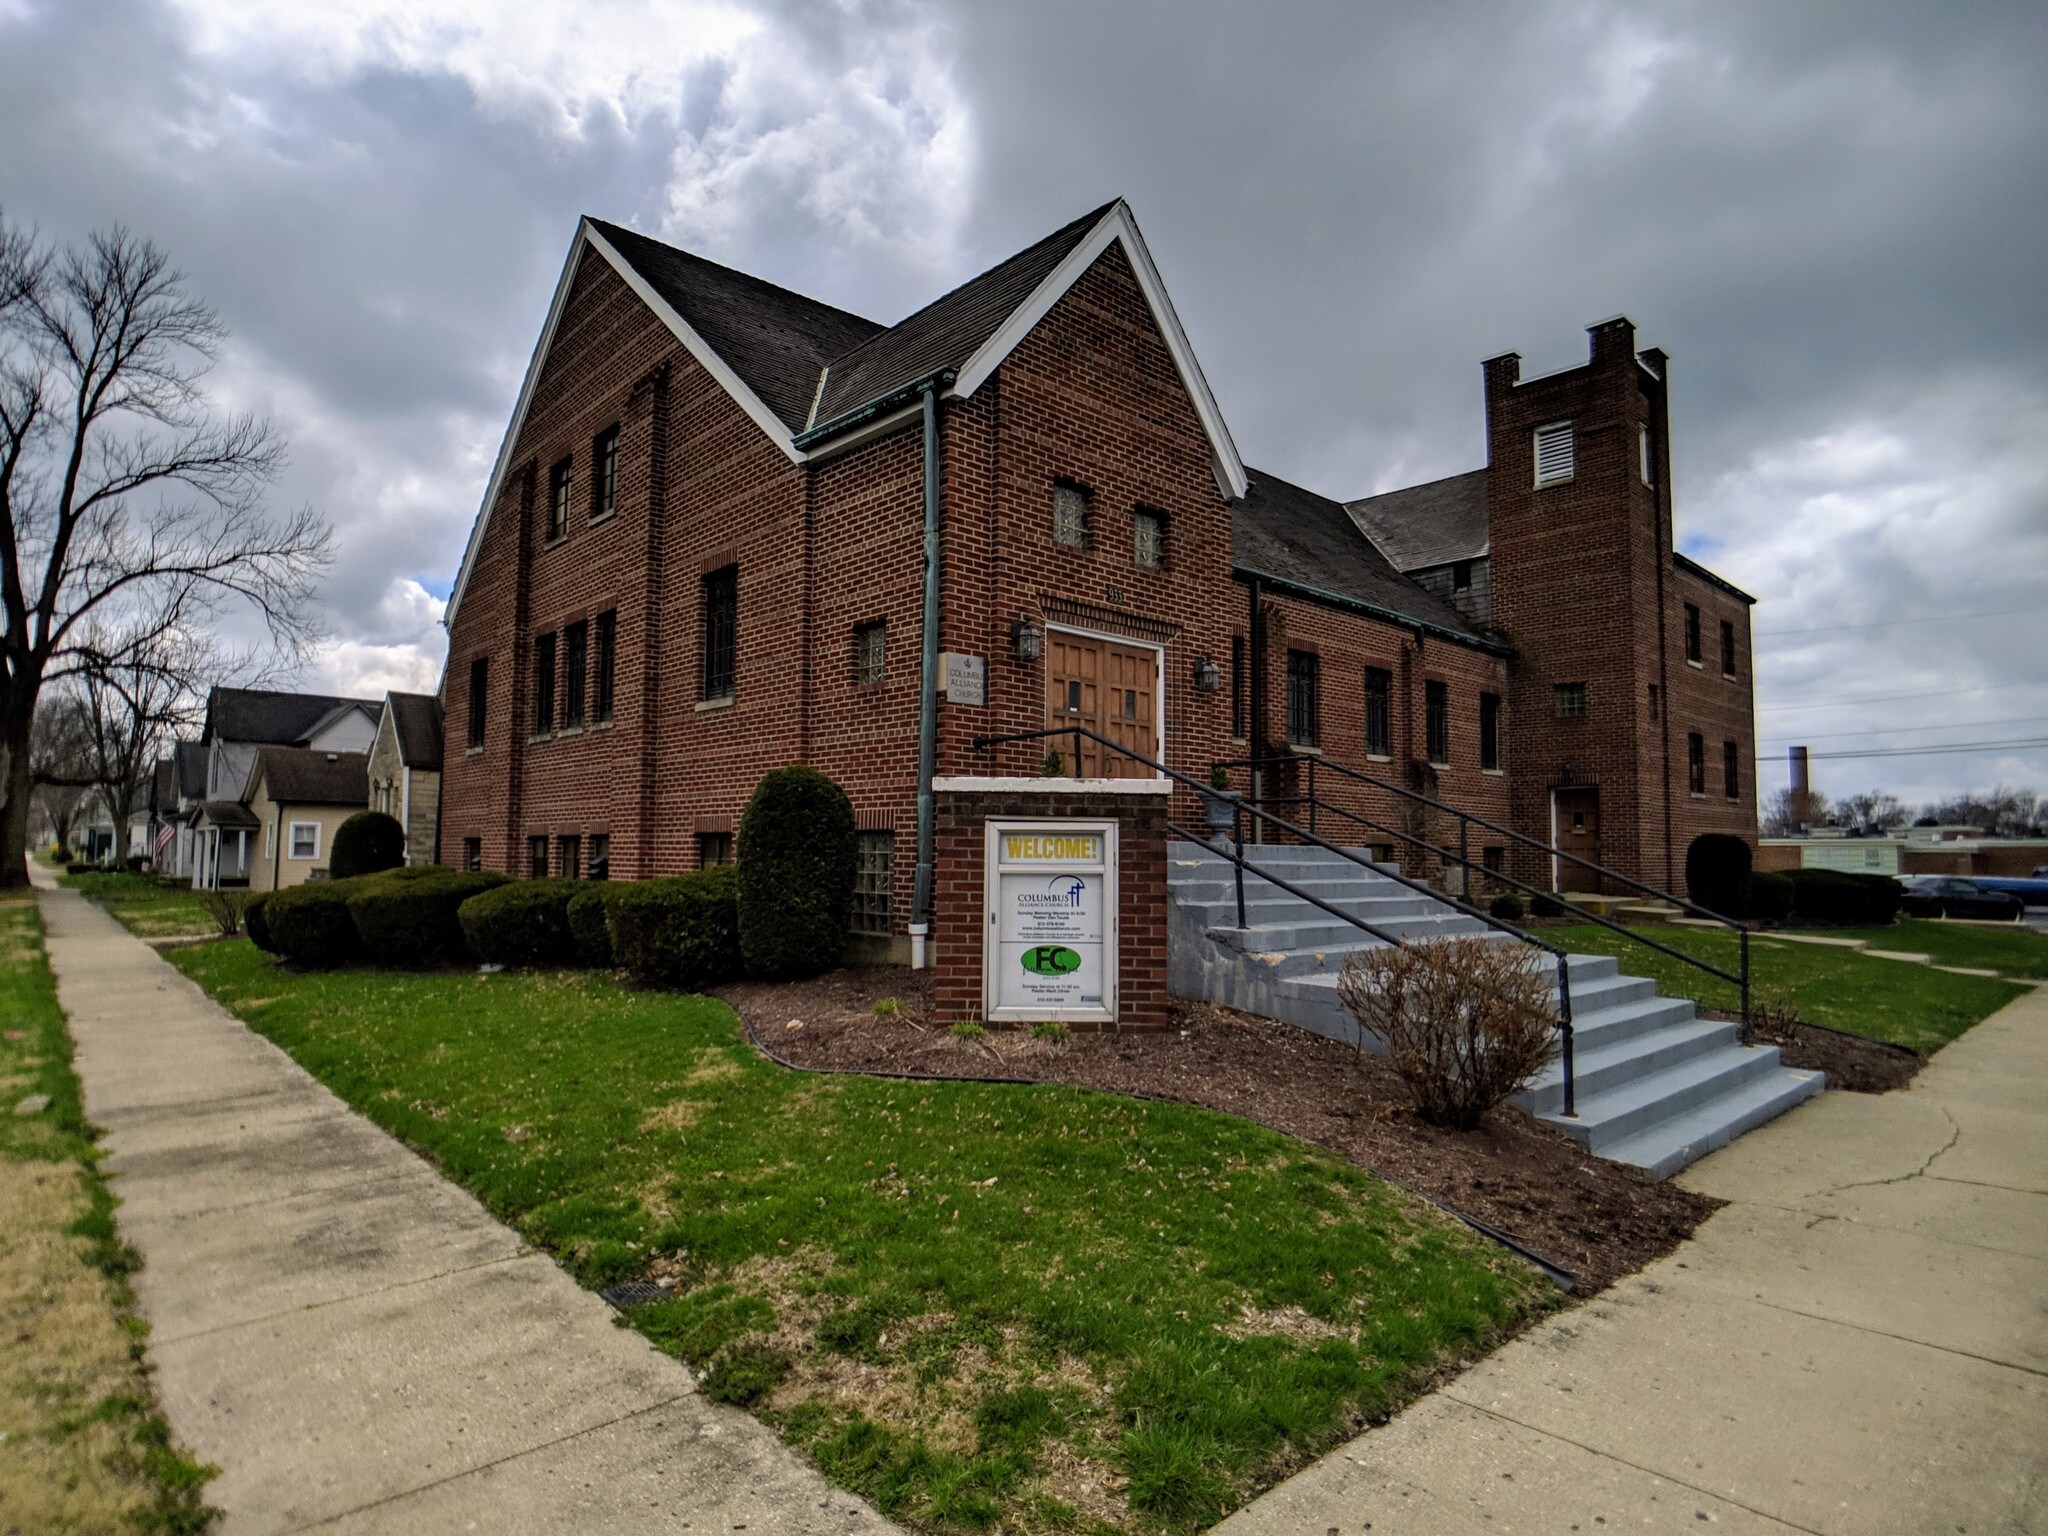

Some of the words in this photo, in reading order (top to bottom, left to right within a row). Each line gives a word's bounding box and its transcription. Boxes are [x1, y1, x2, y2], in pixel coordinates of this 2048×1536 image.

[950, 669, 984, 681] COLUMBU
[955, 689, 982, 699] CHURCH
[1007, 837, 1097, 859] WELCOME!
[1017, 894, 1069, 902] COLUMBUS
